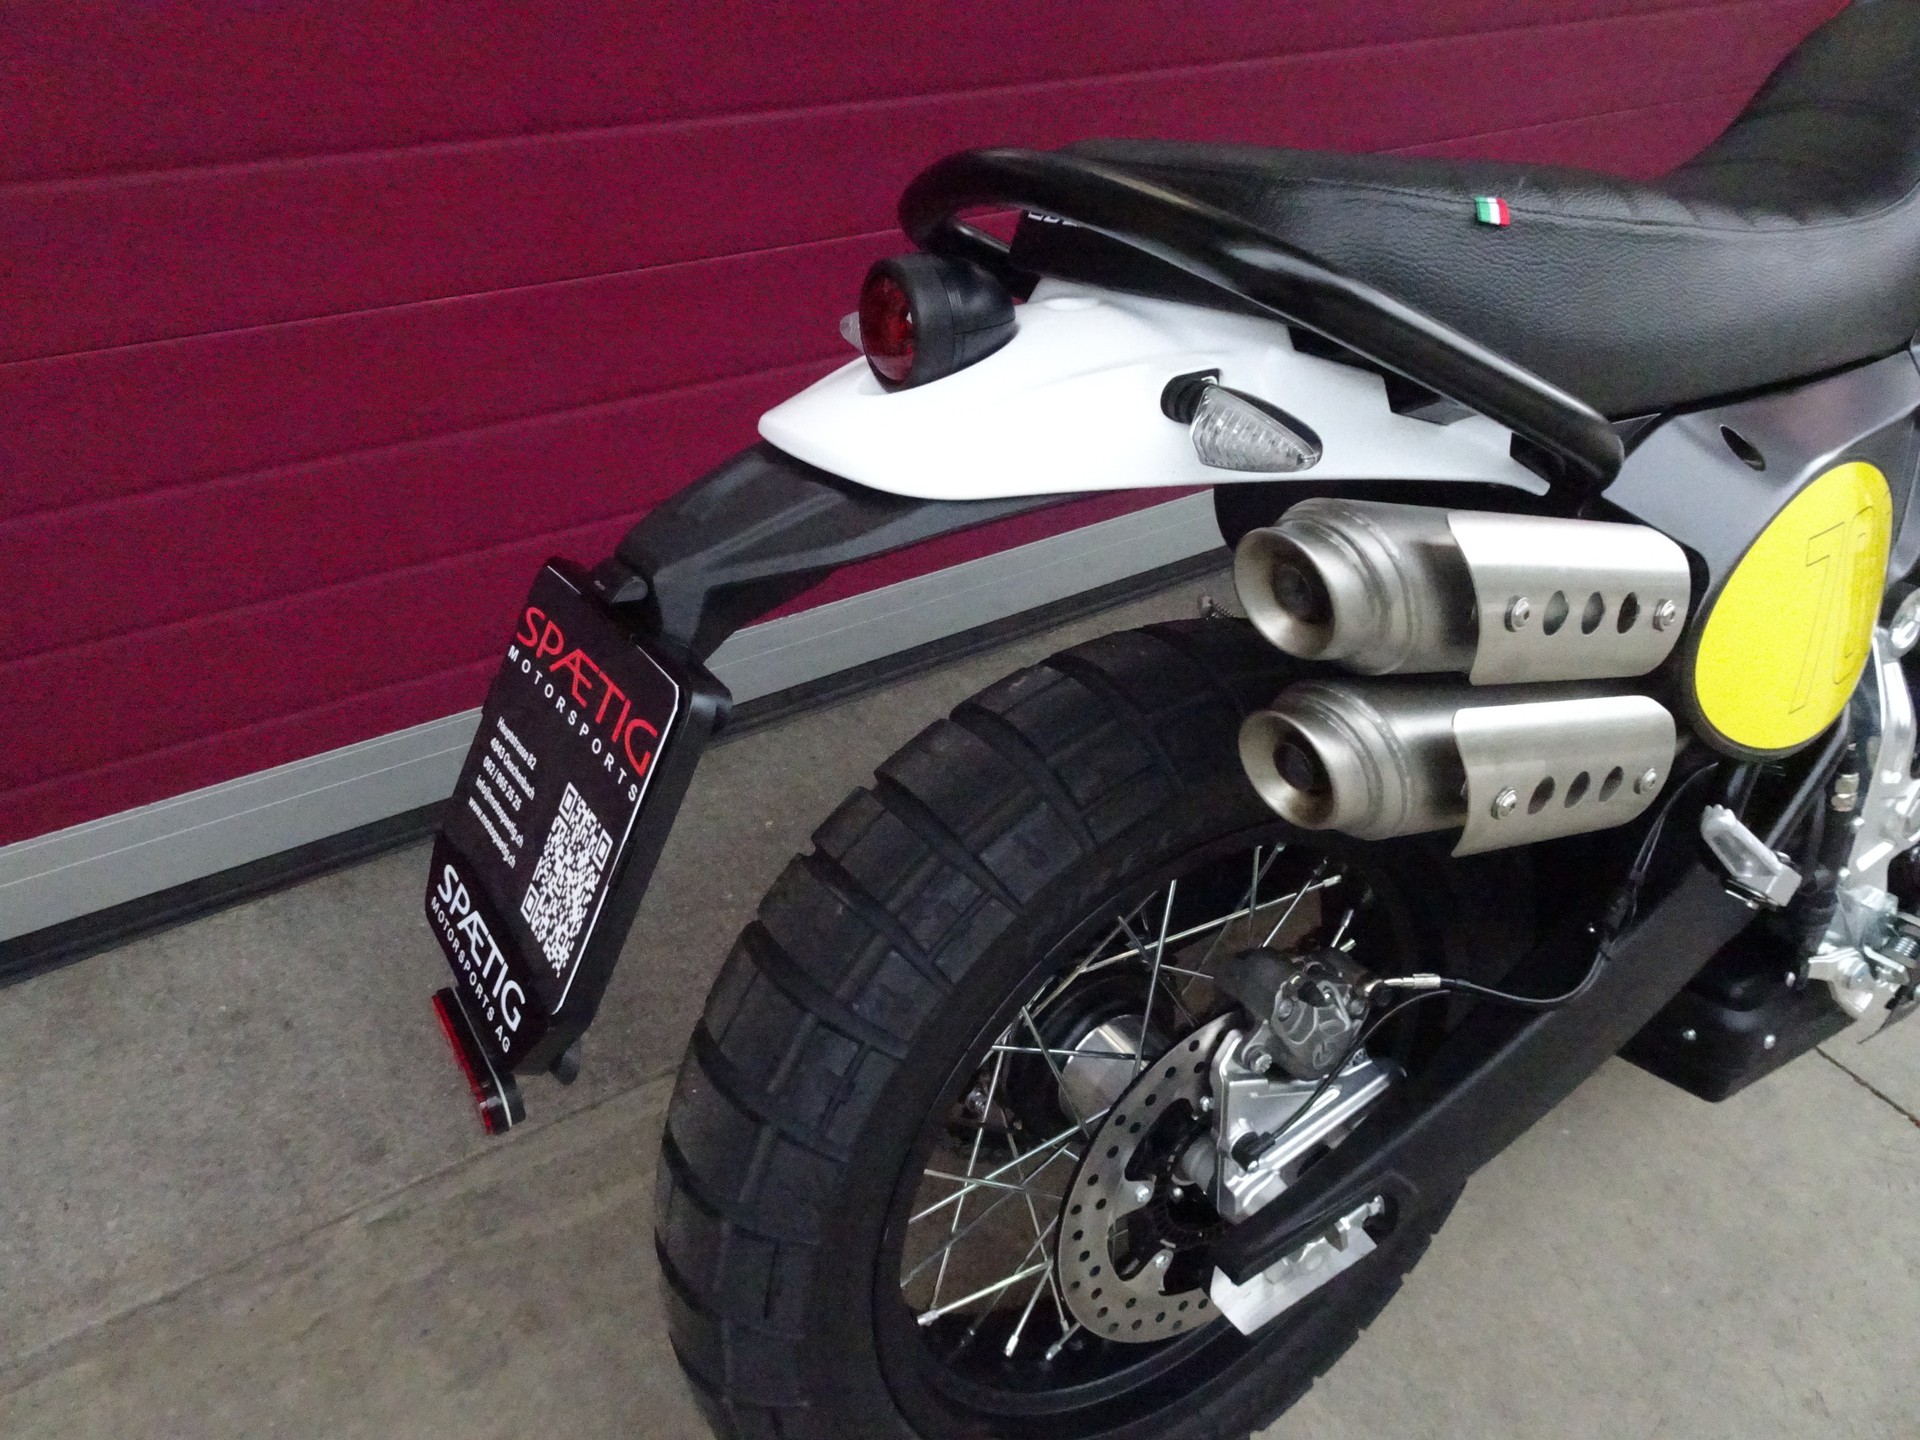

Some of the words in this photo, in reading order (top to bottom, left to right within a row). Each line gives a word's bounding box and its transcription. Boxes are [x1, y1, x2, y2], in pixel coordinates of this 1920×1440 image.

[497, 716, 529, 761] Hauptstrasse
[508, 645, 638, 801] MOTORSPORTS
[483, 755, 496, 776] 062
[505, 785, 514, 802] 25
[512, 795, 522, 811] 25
[490, 737, 505, 760] 4943
[503, 753, 535, 800] Oeschenbach
[469, 796, 516, 869] www.motospaetig.ch
[475, 774, 524, 848] info@motospaetig.ch
[431, 896, 495, 1022] MOTORSPORTS
[495, 1025, 510, 1053] AG
